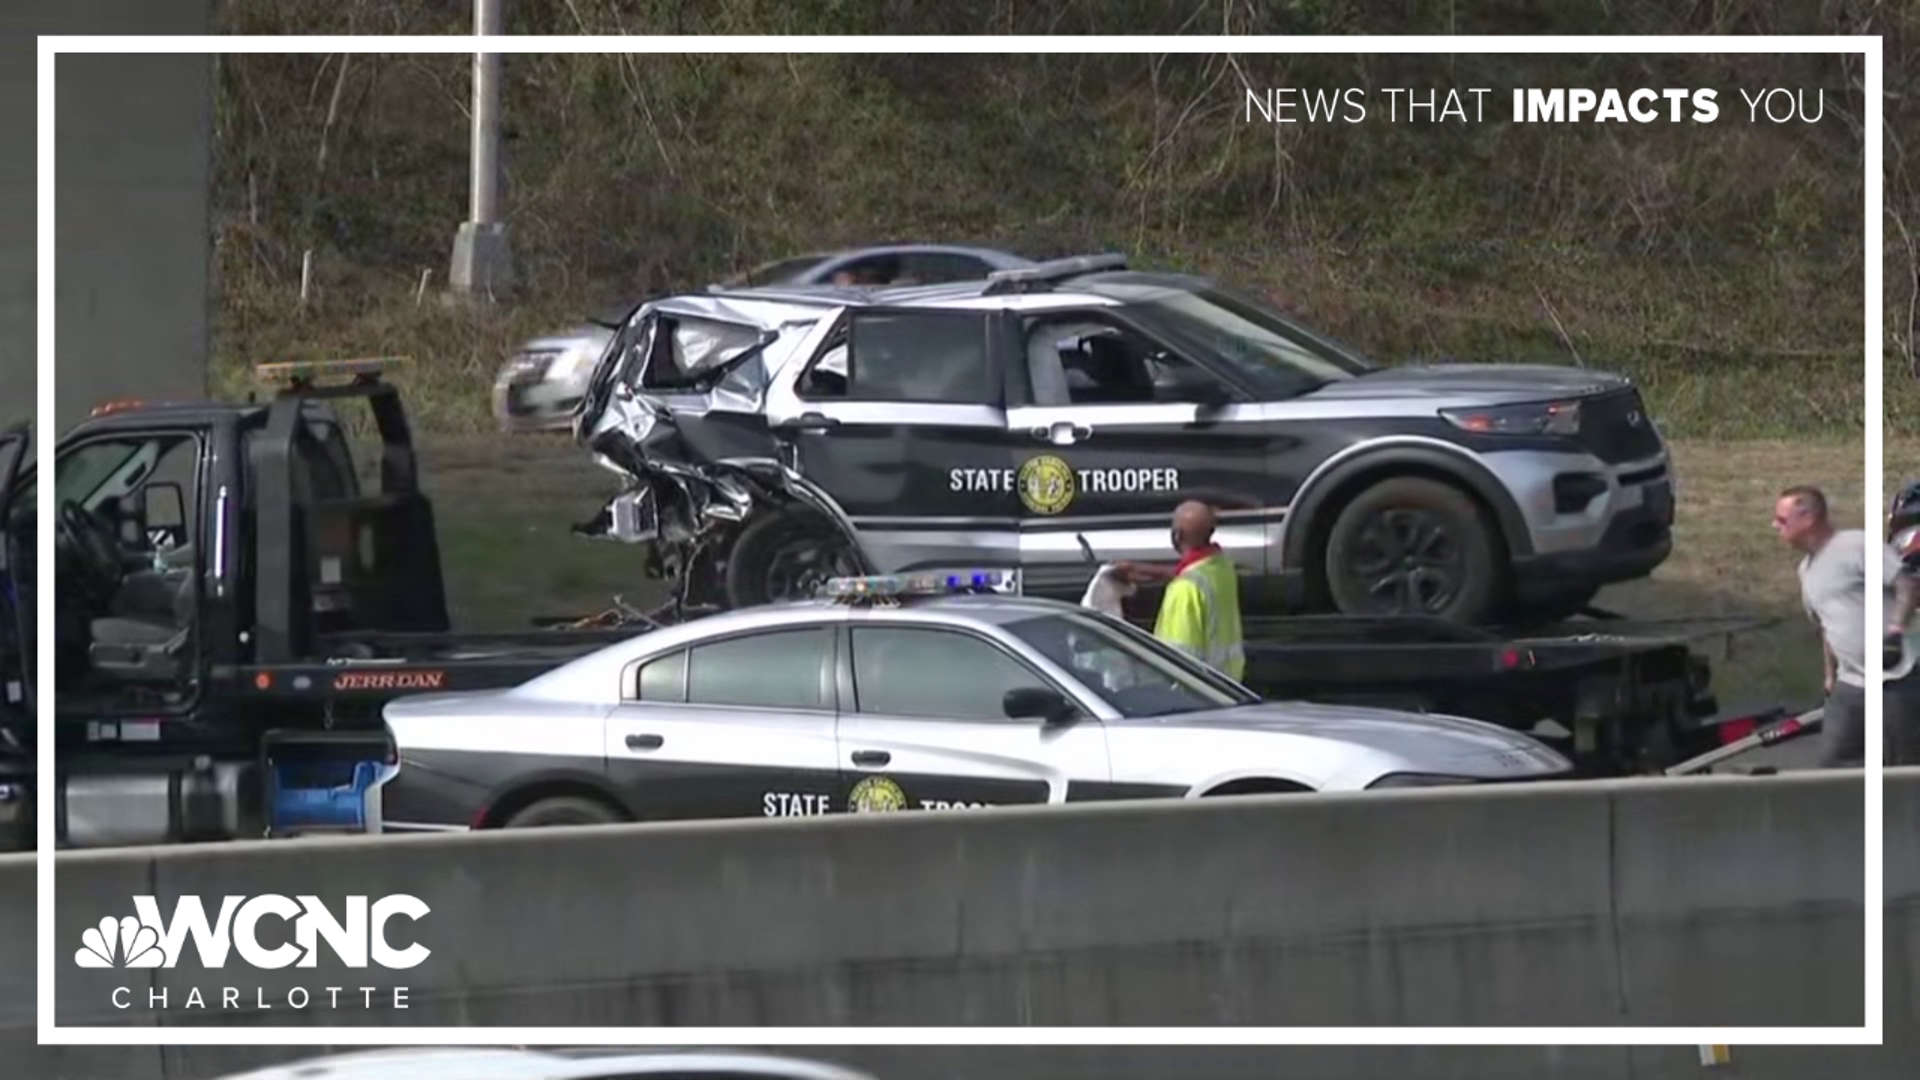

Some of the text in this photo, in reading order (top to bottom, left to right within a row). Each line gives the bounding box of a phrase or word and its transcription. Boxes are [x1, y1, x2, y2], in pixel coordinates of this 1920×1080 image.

[950, 468, 1015, 492] STATE
[1078, 468, 1179, 492] TROOPER
[763, 792, 830, 816] STATE
